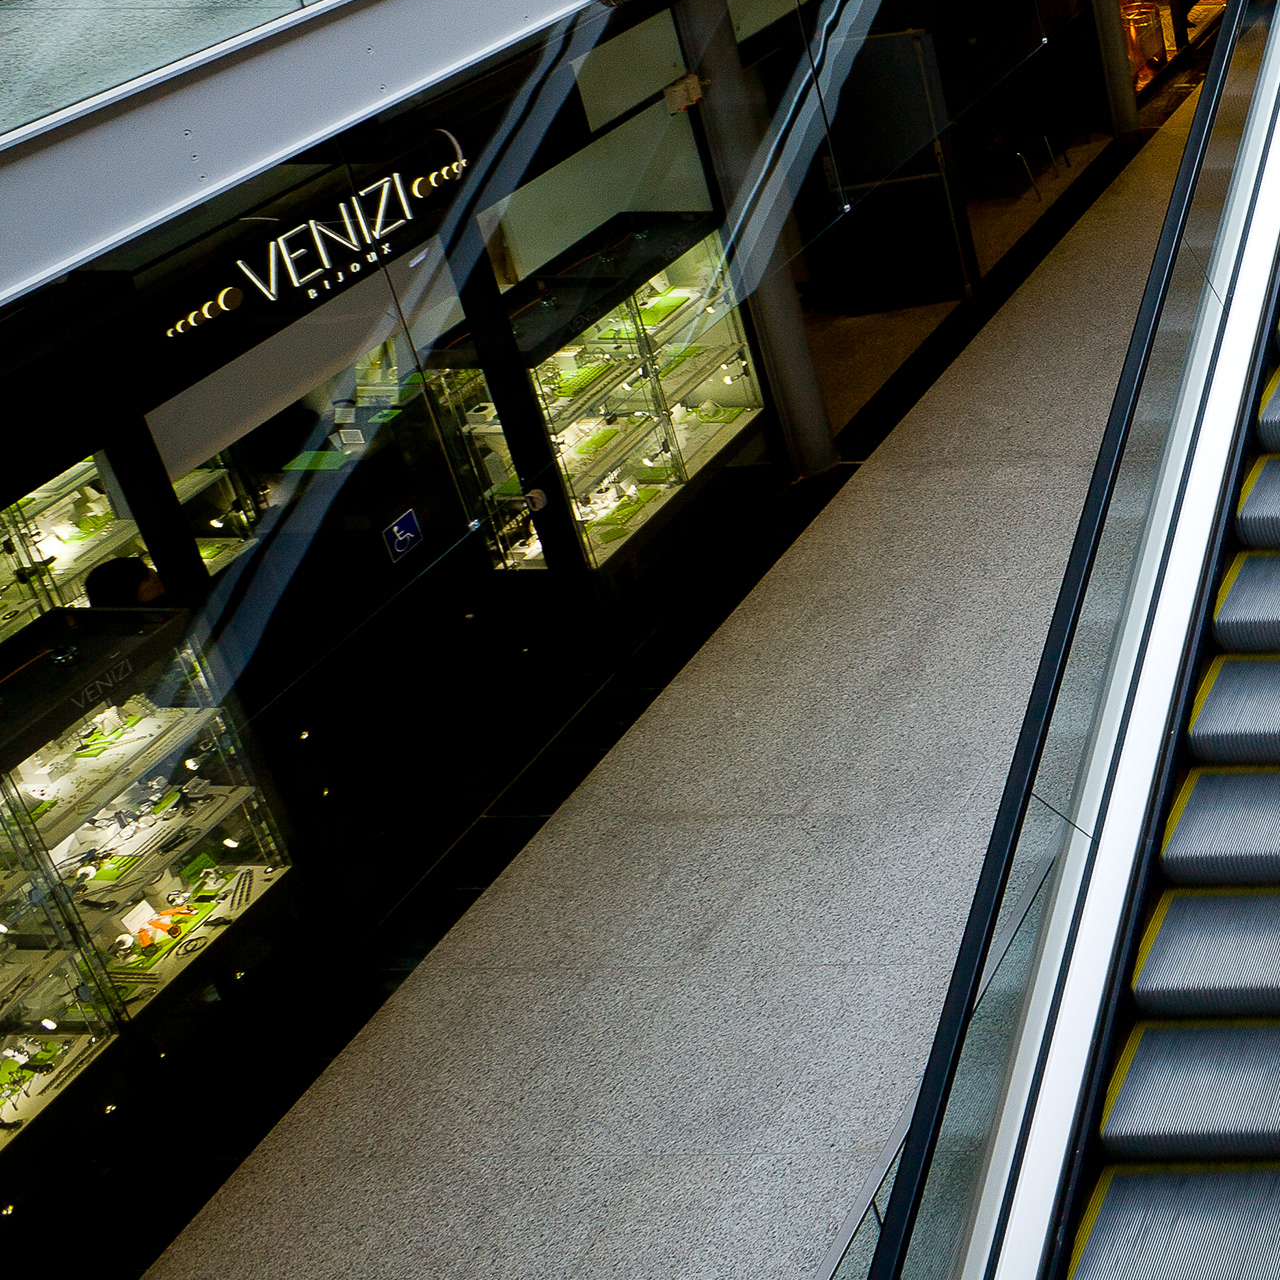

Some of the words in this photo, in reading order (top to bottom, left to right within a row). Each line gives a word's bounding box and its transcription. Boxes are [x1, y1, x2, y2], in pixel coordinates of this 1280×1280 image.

[236, 172, 414, 301] VENIZI
[307, 242, 392, 299] BIJOUX
[70, 658, 133, 708] VENIZI
